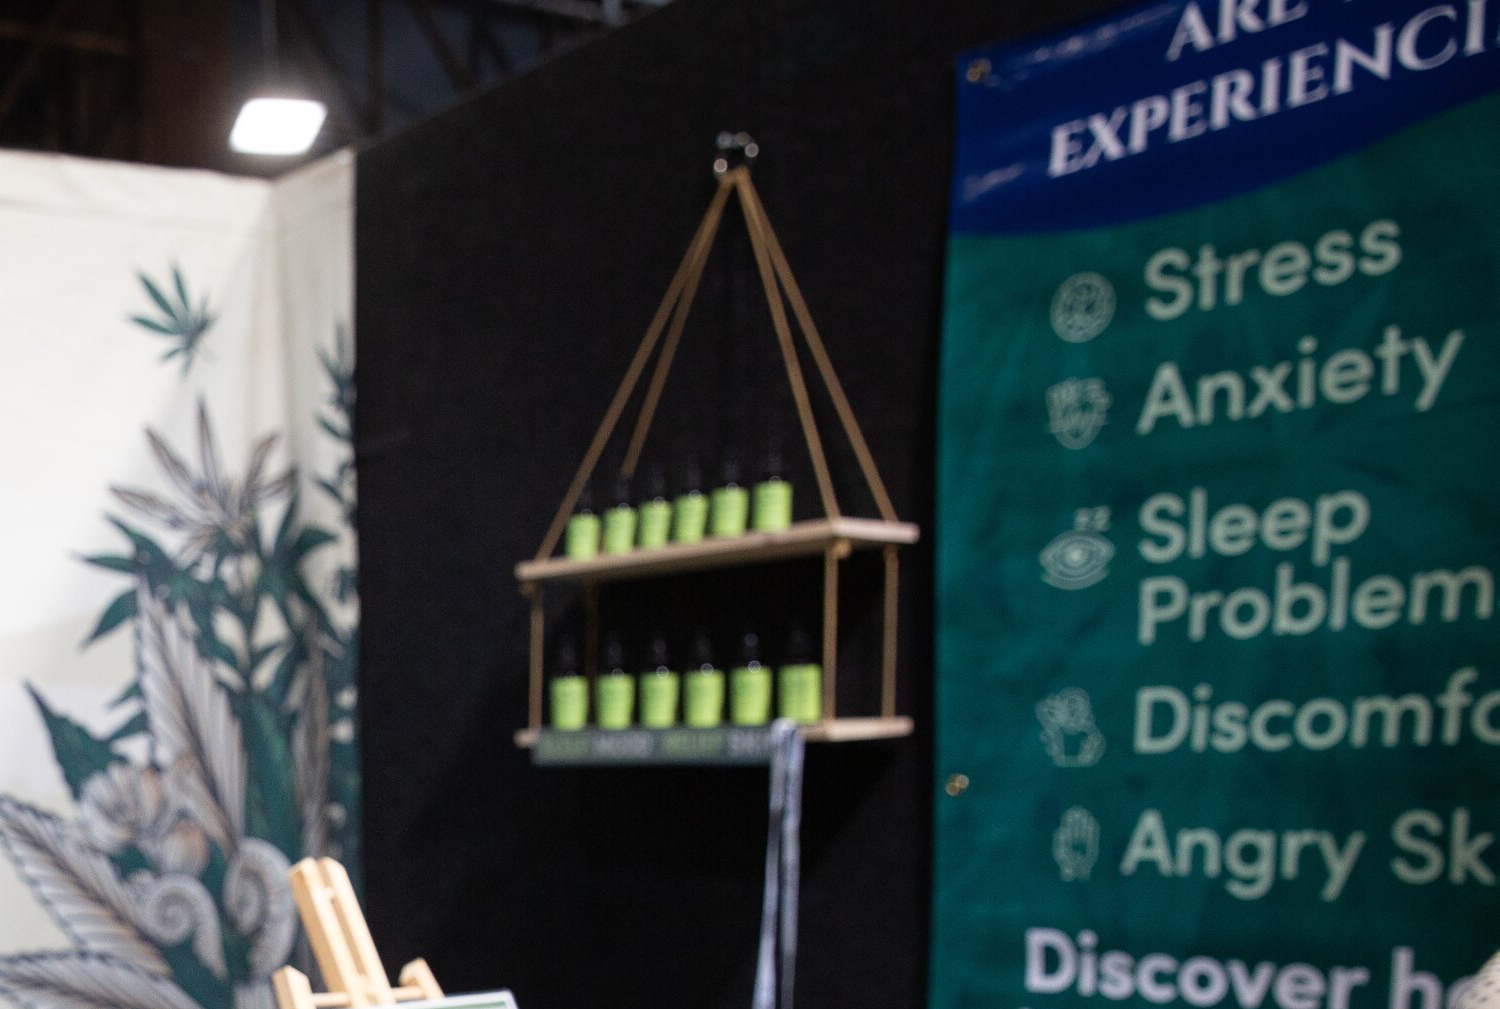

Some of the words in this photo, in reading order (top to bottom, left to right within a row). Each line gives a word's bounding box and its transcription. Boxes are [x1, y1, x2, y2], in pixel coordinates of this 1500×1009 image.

[1165, 0, 1308, 61] ARE
[1048, 0, 1500, 177] EXPERIENCI
[1144, 218, 1402, 320] Stress
[1135, 323, 1465, 435] Anxiety
[1138, 485, 1371, 567] Sleep
[1119, 808, 1366, 902] Angry
